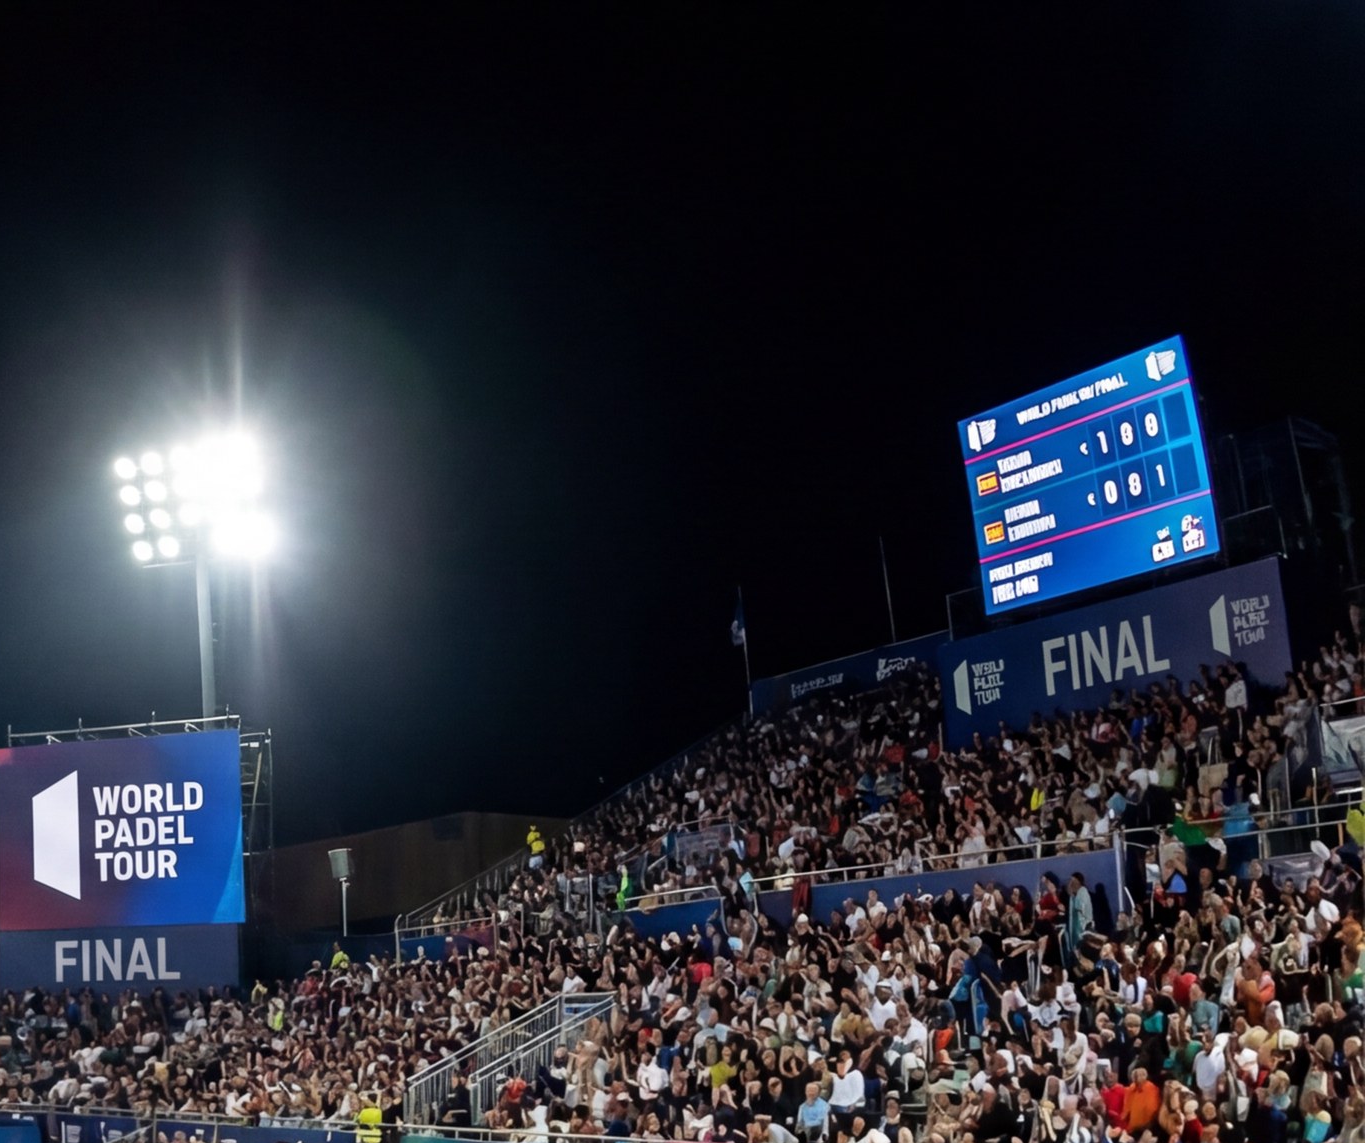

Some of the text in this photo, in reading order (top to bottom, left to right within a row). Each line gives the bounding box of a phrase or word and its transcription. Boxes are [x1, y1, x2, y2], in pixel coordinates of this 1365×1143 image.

[1042, 614, 1171, 697] FINAL
[93, 781, 204, 816] WORLD
[94, 815, 194, 849] PADEL
[94, 849, 178, 882] TOUR
[55, 937, 181, 983] FINAL
